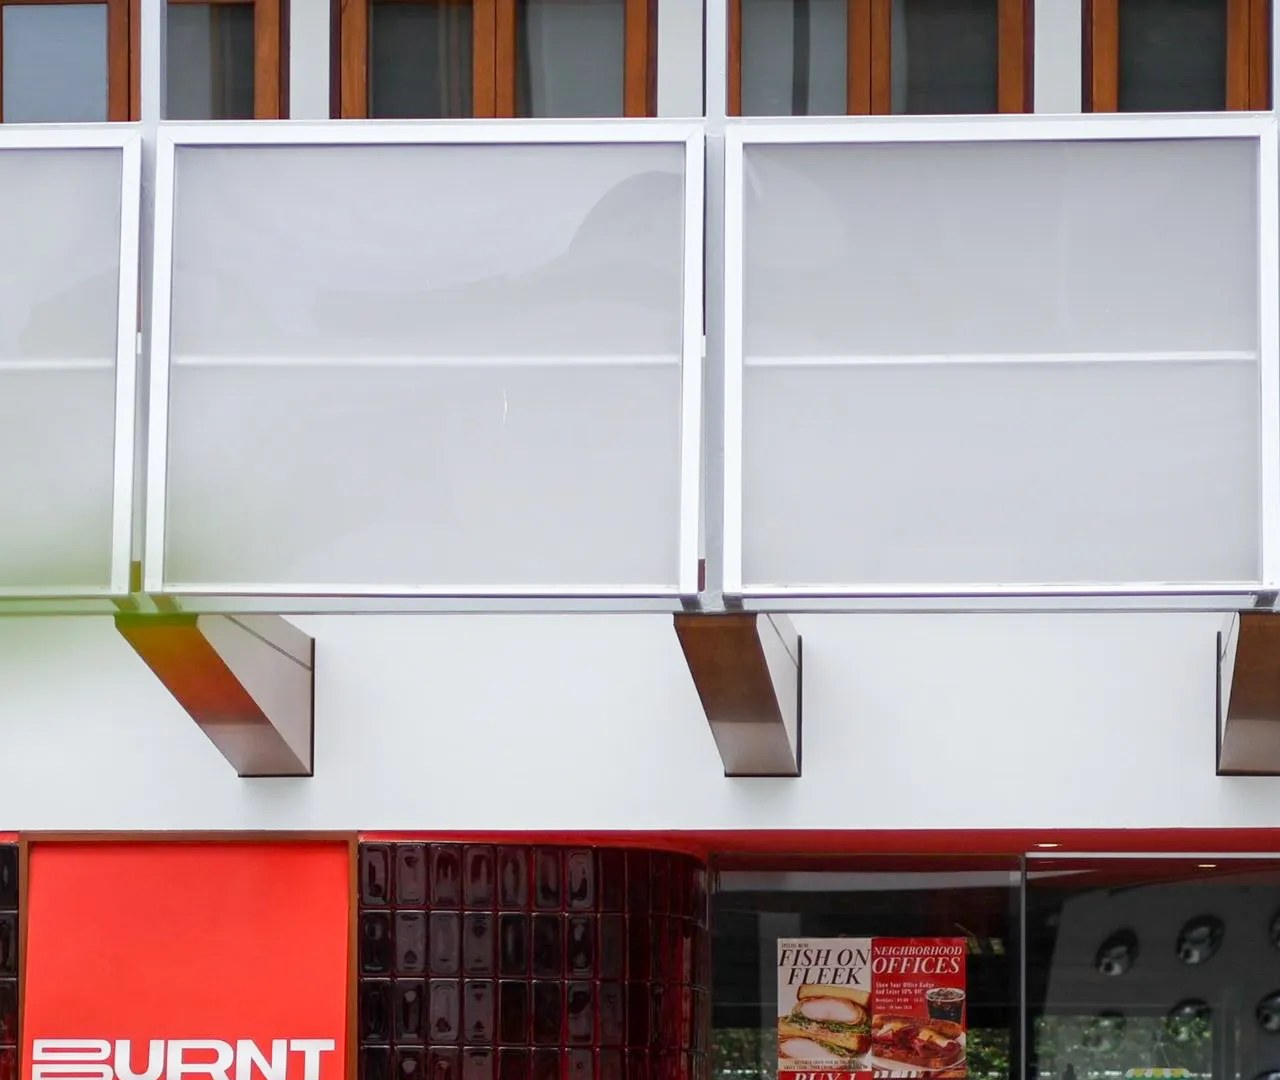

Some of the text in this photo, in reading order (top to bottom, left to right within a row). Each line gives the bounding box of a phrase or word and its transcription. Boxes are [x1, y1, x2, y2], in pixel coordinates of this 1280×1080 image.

[779, 948, 870, 967] FISH ON
[873, 946, 962, 956] NEIGHBORHOOD
[872, 956, 961, 974] OFFICES
[788, 967, 862, 985] FLEEK
